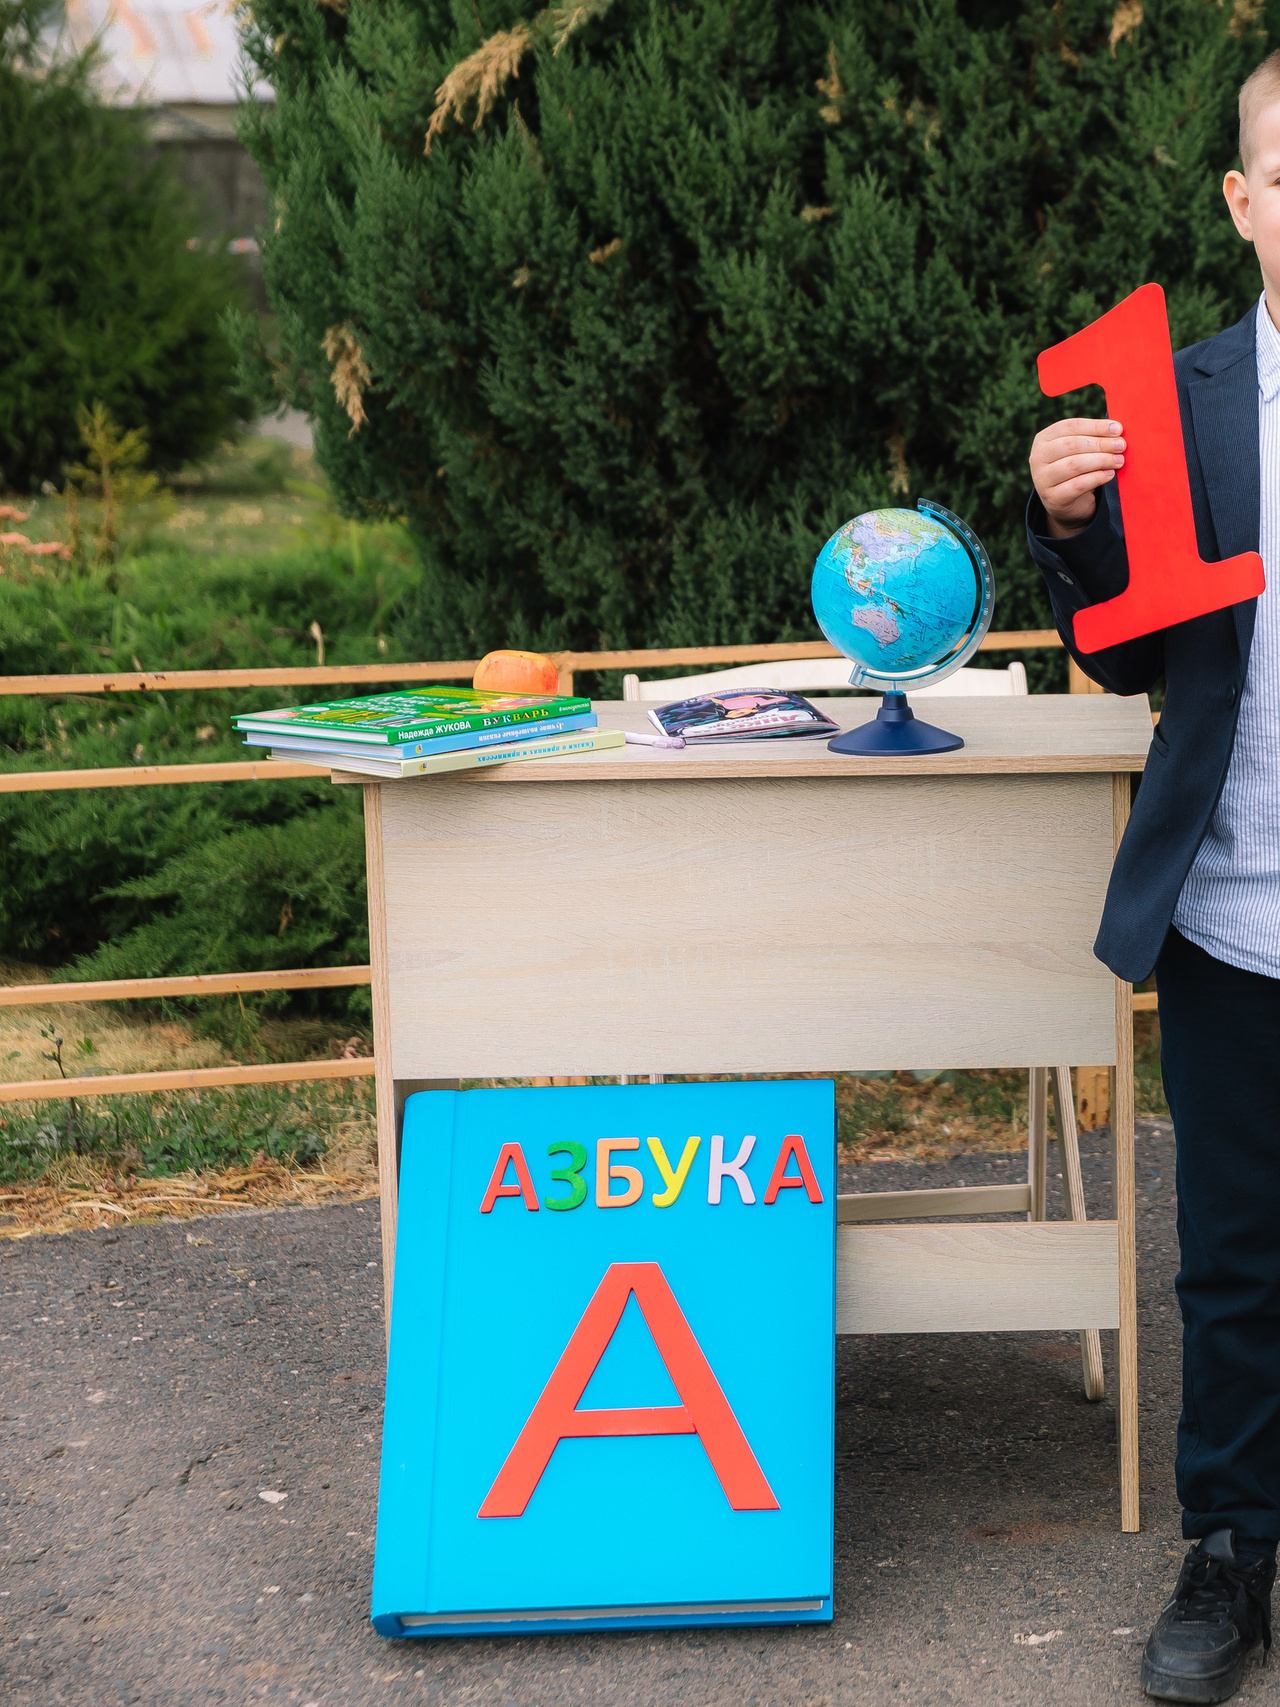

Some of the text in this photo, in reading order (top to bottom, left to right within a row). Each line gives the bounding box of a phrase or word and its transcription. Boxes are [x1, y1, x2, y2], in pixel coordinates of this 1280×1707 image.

[1036, 282, 1266, 655] 1
[398, 709, 549, 740] Надежда ЖУКОВА БУКВАРЬ
[479, 1134, 824, 1214] АЗБУКА
[476, 1261, 781, 1519] А
